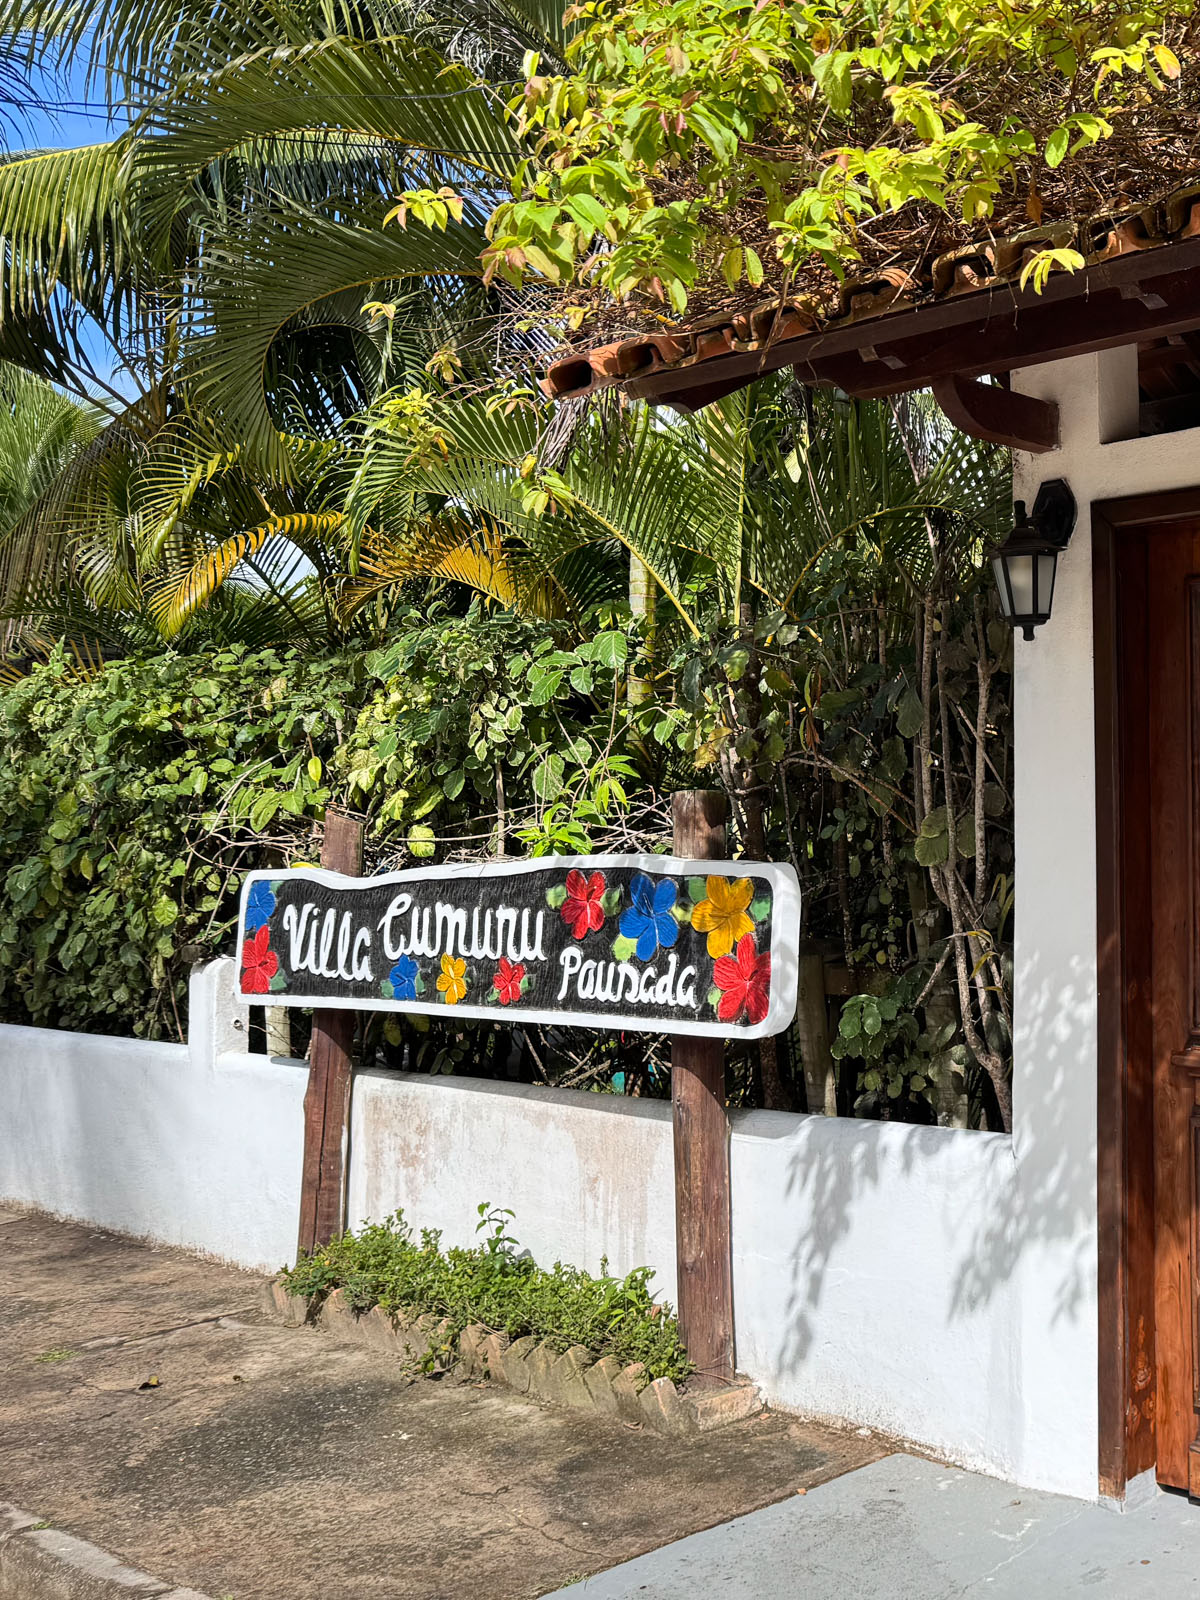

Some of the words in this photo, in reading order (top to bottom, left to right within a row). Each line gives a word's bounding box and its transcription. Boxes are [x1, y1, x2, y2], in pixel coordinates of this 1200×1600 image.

[283, 903, 374, 982] Villa
[377, 893, 547, 962] Cumuru
[558, 946, 697, 1008] Pousada
